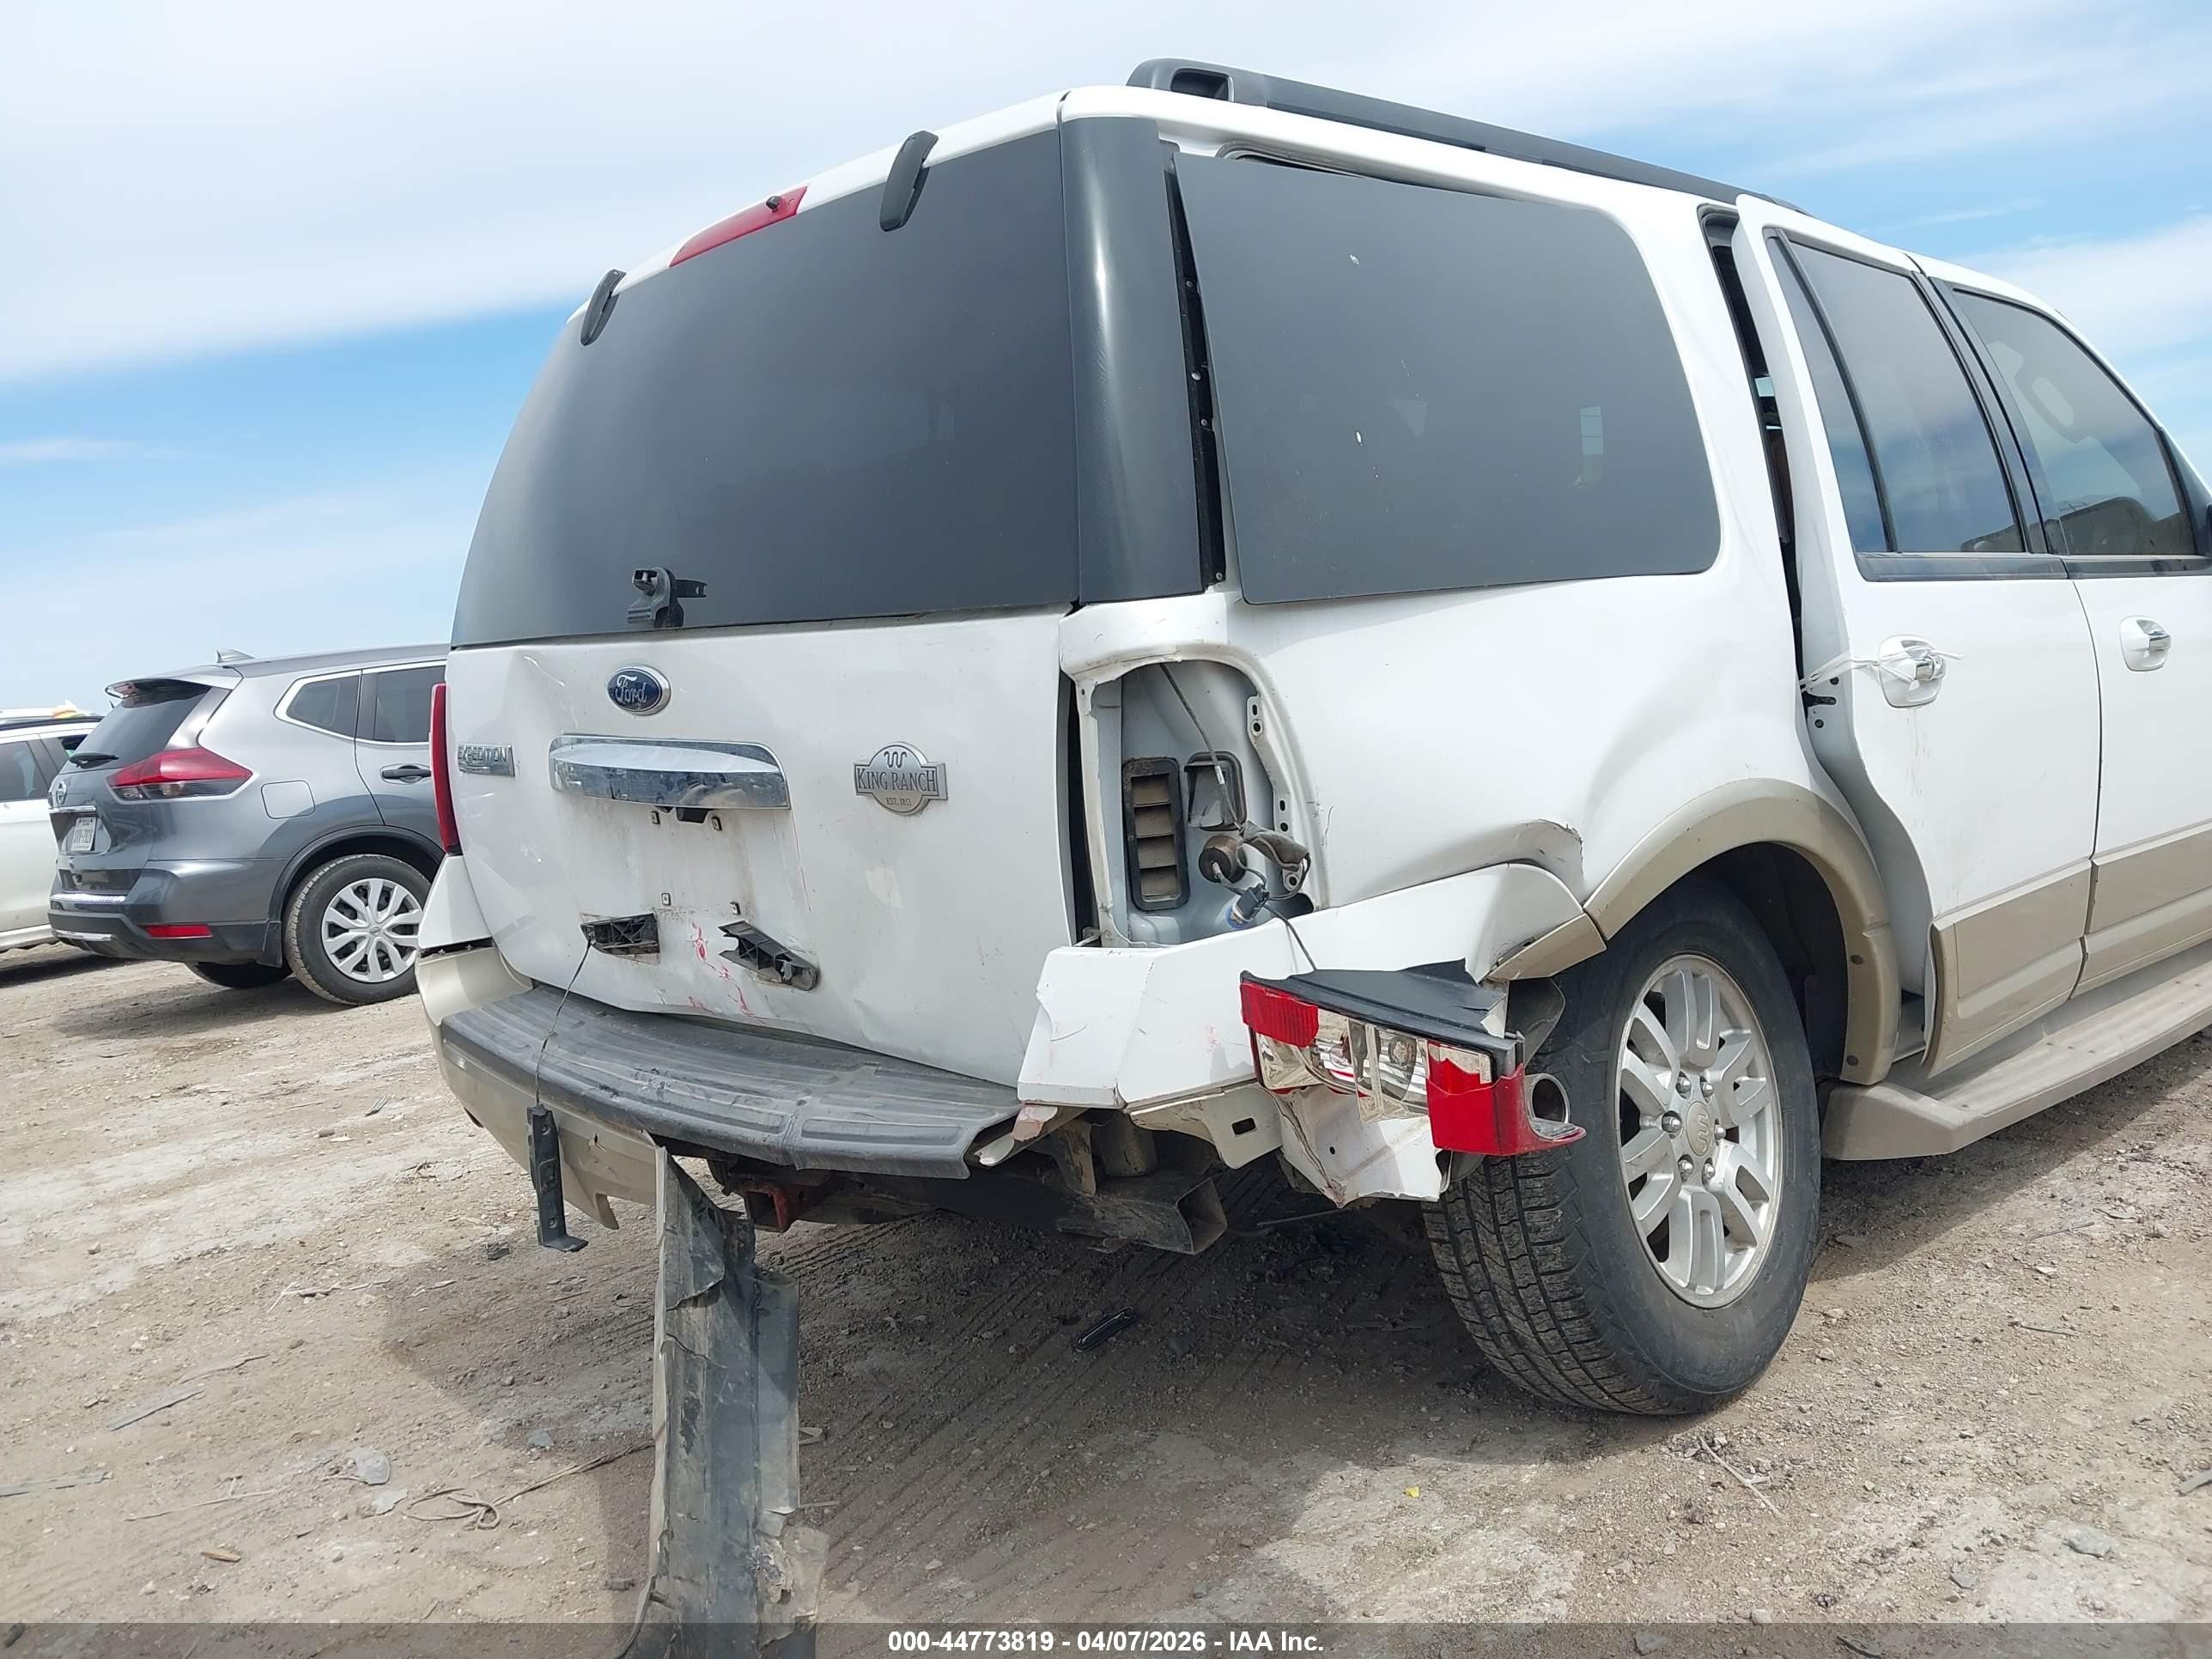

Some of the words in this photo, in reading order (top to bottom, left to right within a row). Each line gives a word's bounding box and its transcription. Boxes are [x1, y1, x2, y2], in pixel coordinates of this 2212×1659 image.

[615, 674, 647, 703] Ford
[458, 745, 507, 763] EXPEDITION
[856, 768, 888, 791] KING
[891, 769, 937, 792] RANCH
